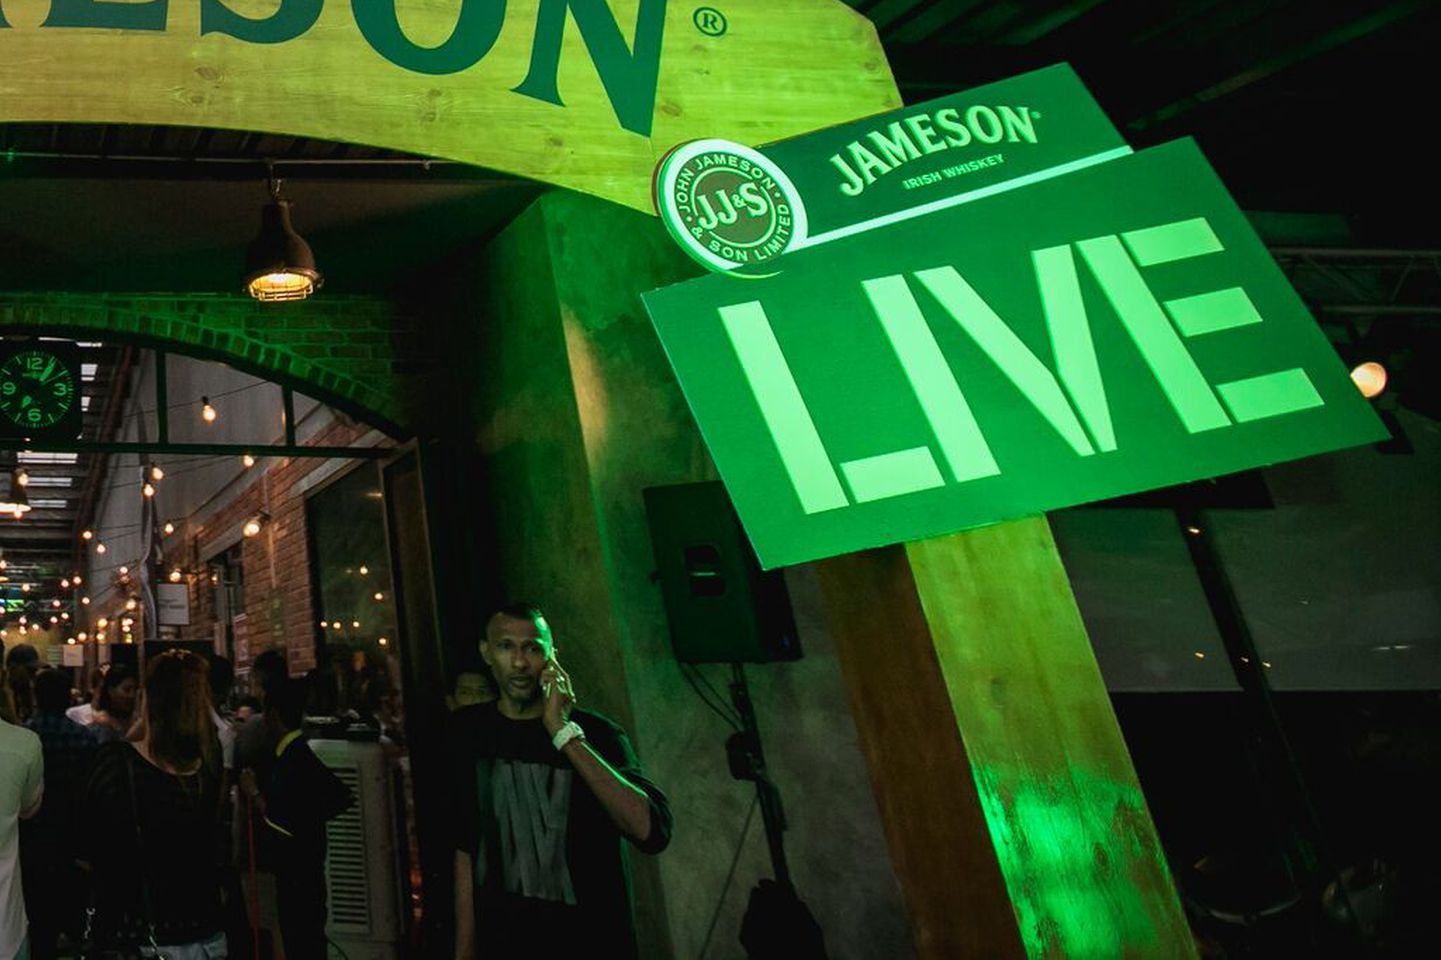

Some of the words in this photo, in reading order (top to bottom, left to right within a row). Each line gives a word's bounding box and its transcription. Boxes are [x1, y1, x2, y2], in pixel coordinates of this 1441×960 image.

[829, 105, 1038, 197] JAMESON
[902, 171, 942, 190] IRISH
[943, 153, 1004, 178] WHISKEY
[676, 168, 695, 213] JOHN
[694, 154, 776, 190] JAMESON
[696, 182, 768, 230] JJ&S
[691, 227, 703, 240] &
[709, 240, 748, 261] SON
[754, 204, 791, 260] LIMITED
[26, 356, 43, 370] 12
[718, 217, 1325, 515] LIVE
[2, 381, 16, 395] 9
[53, 382, 67, 396] 3
[27, 407, 41, 421] 6
